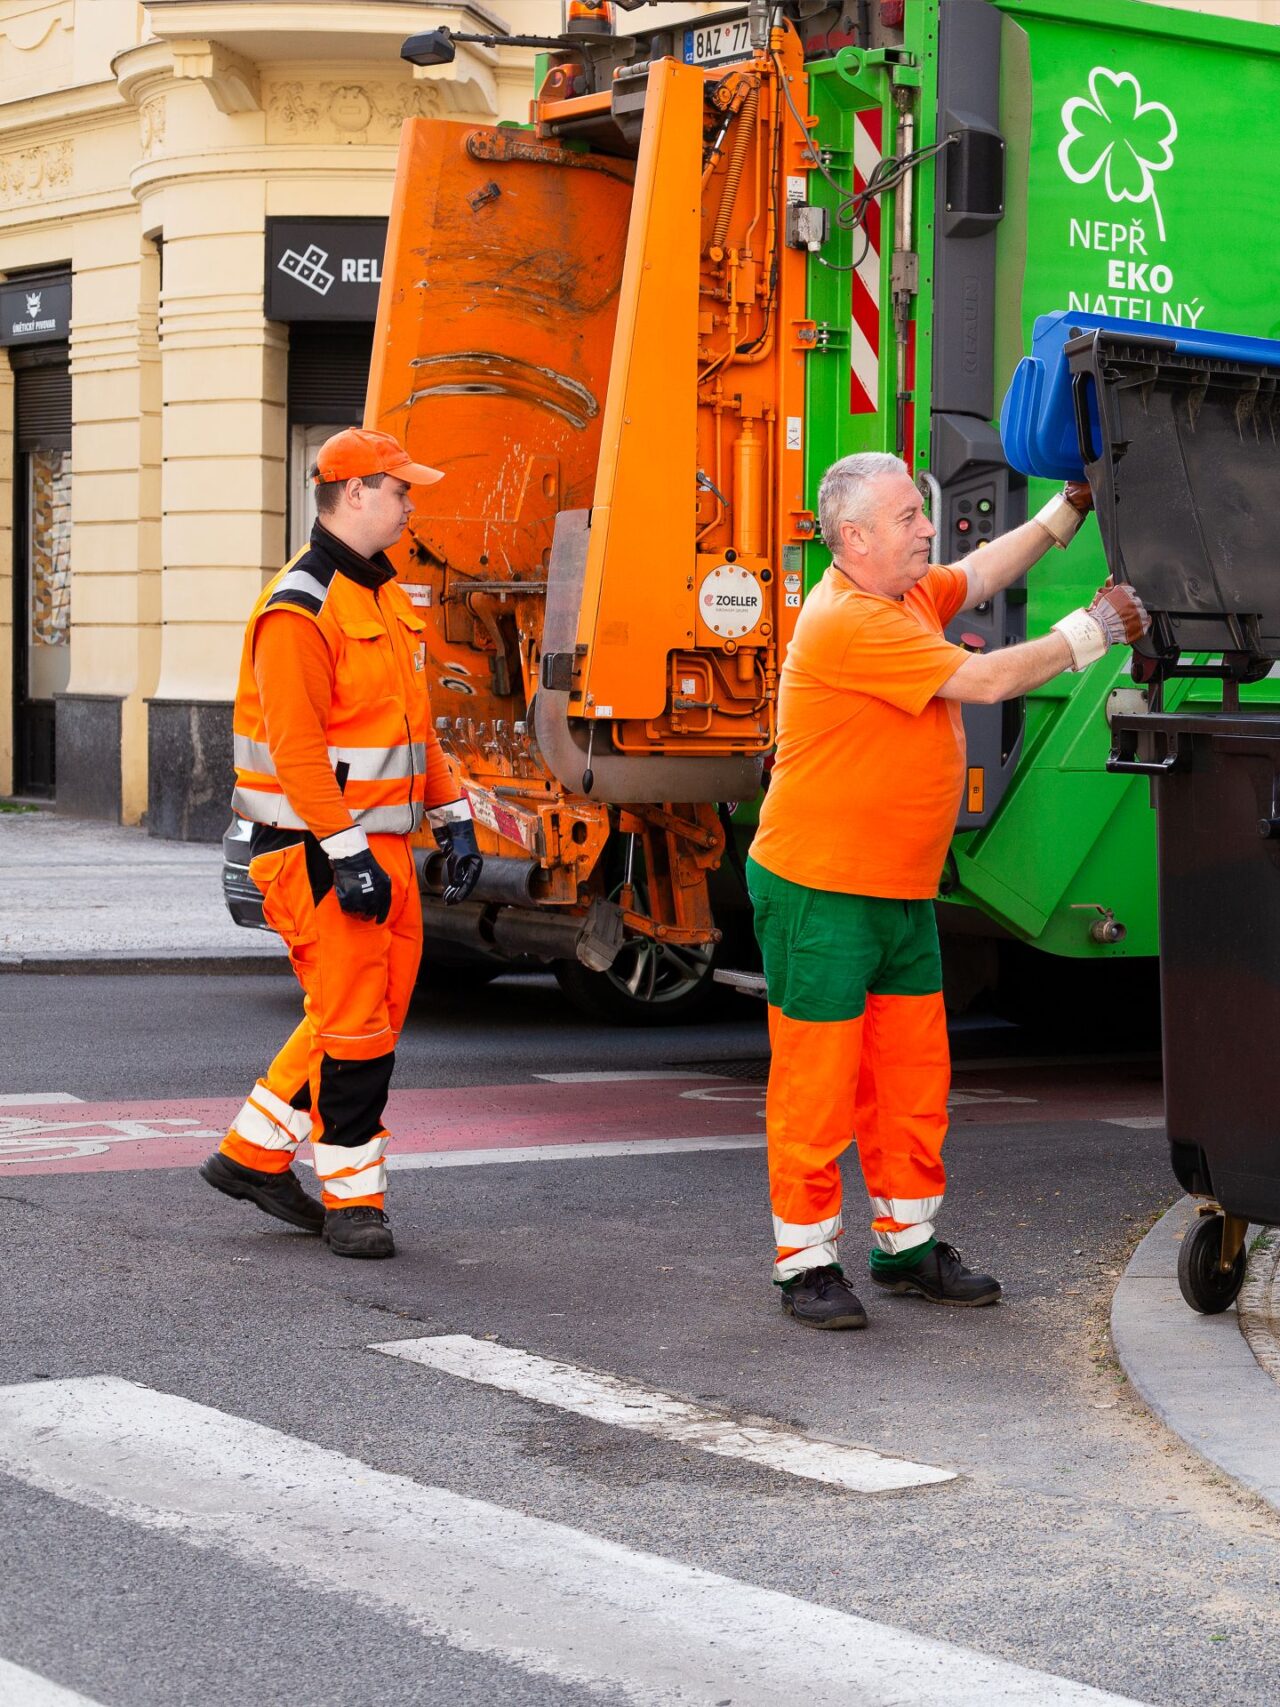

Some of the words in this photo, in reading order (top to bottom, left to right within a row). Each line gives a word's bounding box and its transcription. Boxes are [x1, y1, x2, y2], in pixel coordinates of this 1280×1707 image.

[697, 27, 721, 58] 8AZ
[1069, 217, 1148, 256] NEPŘ
[1108, 259, 1173, 294] EKO
[716, 595, 757, 607] ZOELLER
